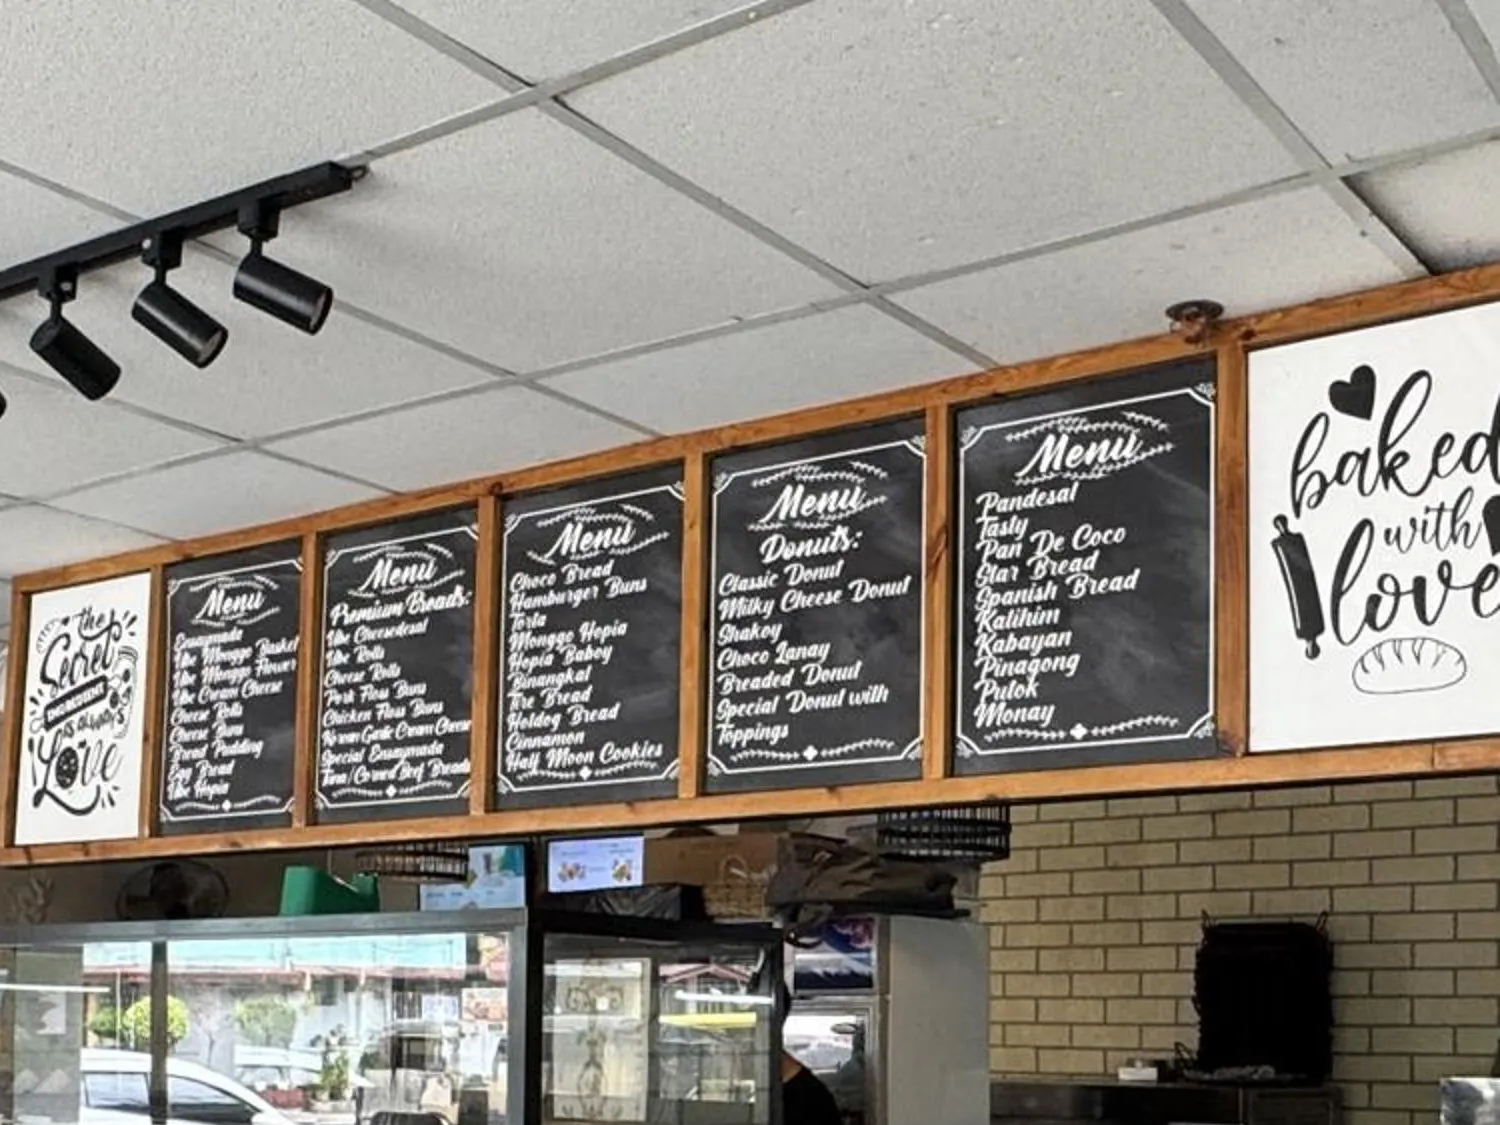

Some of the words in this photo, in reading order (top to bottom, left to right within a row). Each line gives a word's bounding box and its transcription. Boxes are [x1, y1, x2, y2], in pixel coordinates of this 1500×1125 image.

[1014, 433, 1143, 477] Menu
[1290, 369, 1500, 519] baked
[759, 484, 866, 523] Menu
[976, 481, 1079, 519] Pandesal
[976, 515, 1028, 541] Tasty
[1384, 486, 1482, 554] with
[543, 521, 636, 559] Menu
[760, 525, 863, 564] Donuts:
[975, 539, 1023, 564] Pan
[1029, 529, 1065, 558] De
[1071, 523, 1126, 550] Coco
[358, 558, 438, 591] Menu
[510, 572, 557, 593] Choco
[561, 559, 615, 585] Bread
[719, 569, 778, 596] Classic
[784, 559, 845, 586] Donut
[975, 562, 1019, 588] Star
[1026, 550, 1100, 580] Bread
[1331, 518, 1500, 646] love
[195, 588, 265, 619] Menu
[509, 586, 599, 612] Hamburger
[604, 576, 647, 598] Buns
[718, 596, 775, 621] Milky
[780, 589, 842, 612] Cheese
[848, 575, 912, 602] Donut
[975, 580, 1058, 612] Spanish
[1065, 568, 1140, 599] Bread
[330, 599, 404, 627] Premium
[508, 629, 575, 651] Monggo
[579, 619, 628, 644] Hopia
[717, 622, 782, 646] Shakoy
[974, 630, 1073, 656] Kabayan
[508, 651, 554, 673] Hopia
[560, 644, 613, 666] Baboy
[717, 648, 769, 670] Choco
[974, 654, 1081, 681] Pinagong
[716, 668, 794, 695] Breaded
[800, 659, 862, 685] Donut
[540, 684, 593, 708] Bread
[716, 695, 779, 724] Special
[786, 688, 846, 714] Donut
[849, 684, 889, 706] with
[323, 708, 372, 727] Chicken
[567, 701, 621, 726] Bread
[973, 702, 1055, 728] Monay
[506, 731, 585, 752] Cinnamon
[716, 723, 788, 748] Toppings
[506, 751, 540, 773] Half
[546, 747, 595, 768] Moon
[600, 740, 663, 764] Cookies
